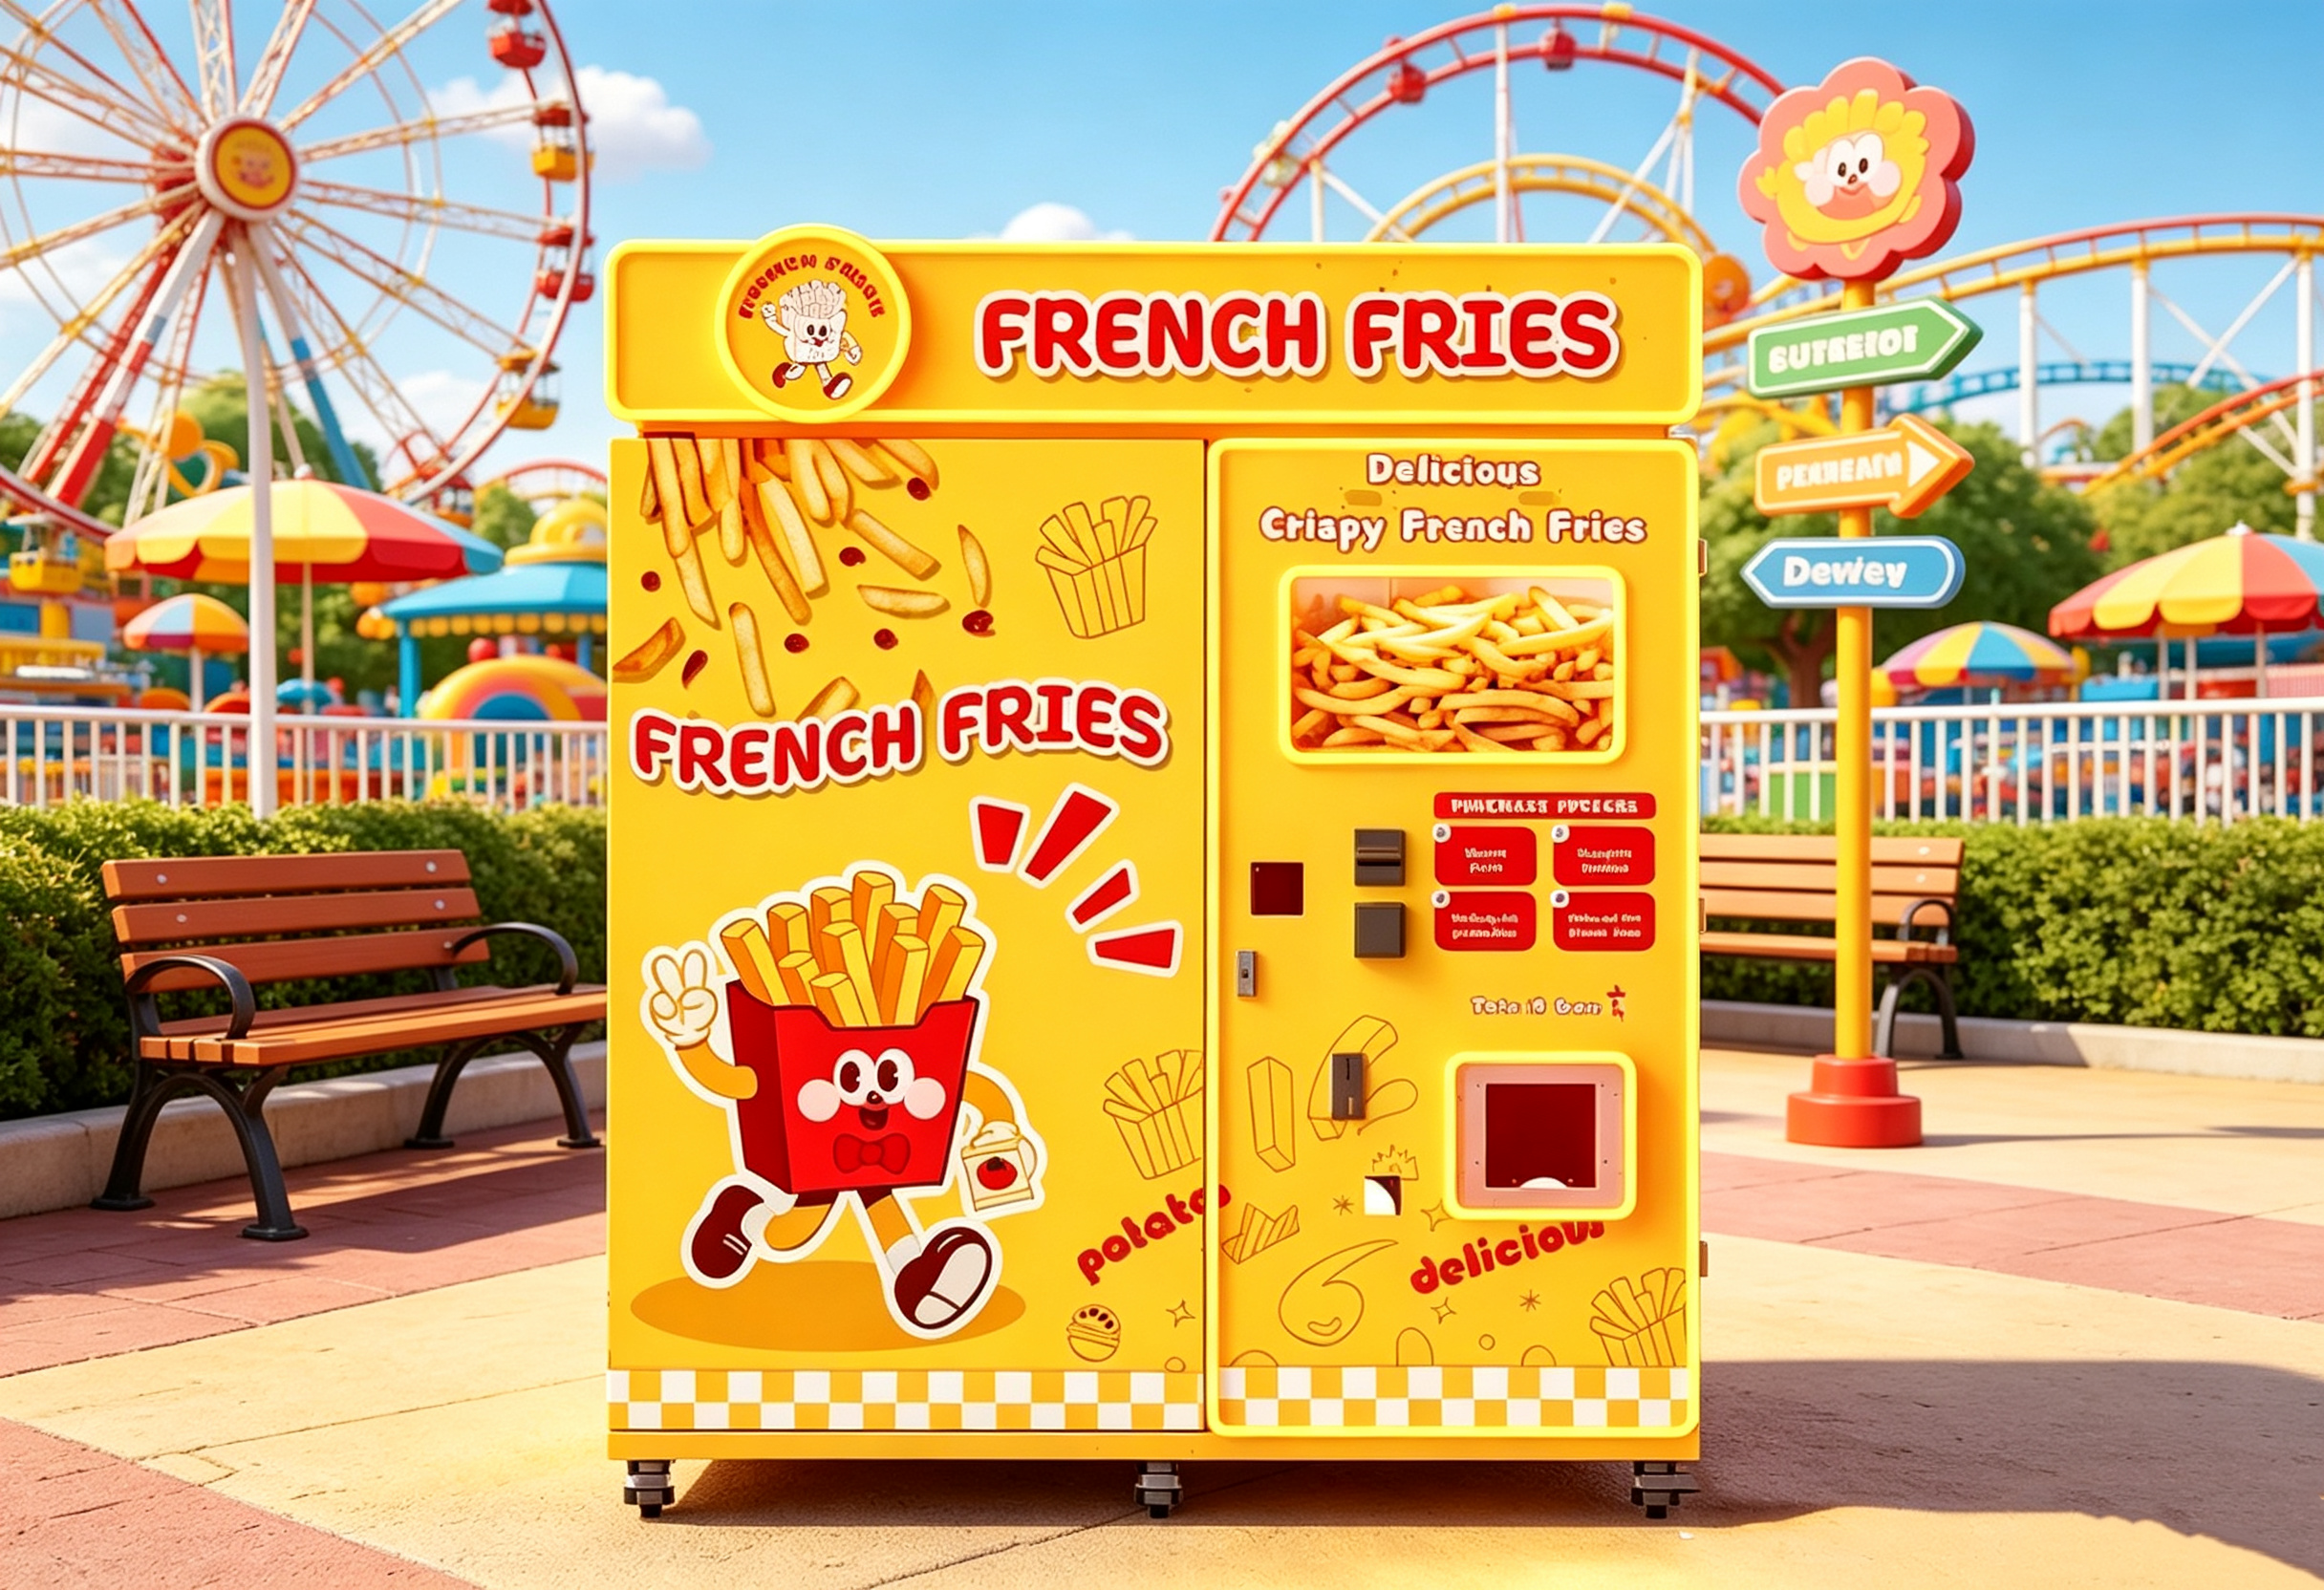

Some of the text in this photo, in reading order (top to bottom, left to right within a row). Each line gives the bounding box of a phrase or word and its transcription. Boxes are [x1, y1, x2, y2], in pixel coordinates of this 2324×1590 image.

[976, 290, 1618, 378] FRENCH FRIES
[1366, 453, 1541, 487] Delicious
[1400, 507, 1533, 543] French
[1546, 508, 1648, 543] Fries
[632, 679, 1166, 796] FRENCH FRIES
[1077, 1183, 1231, 1286] potato
